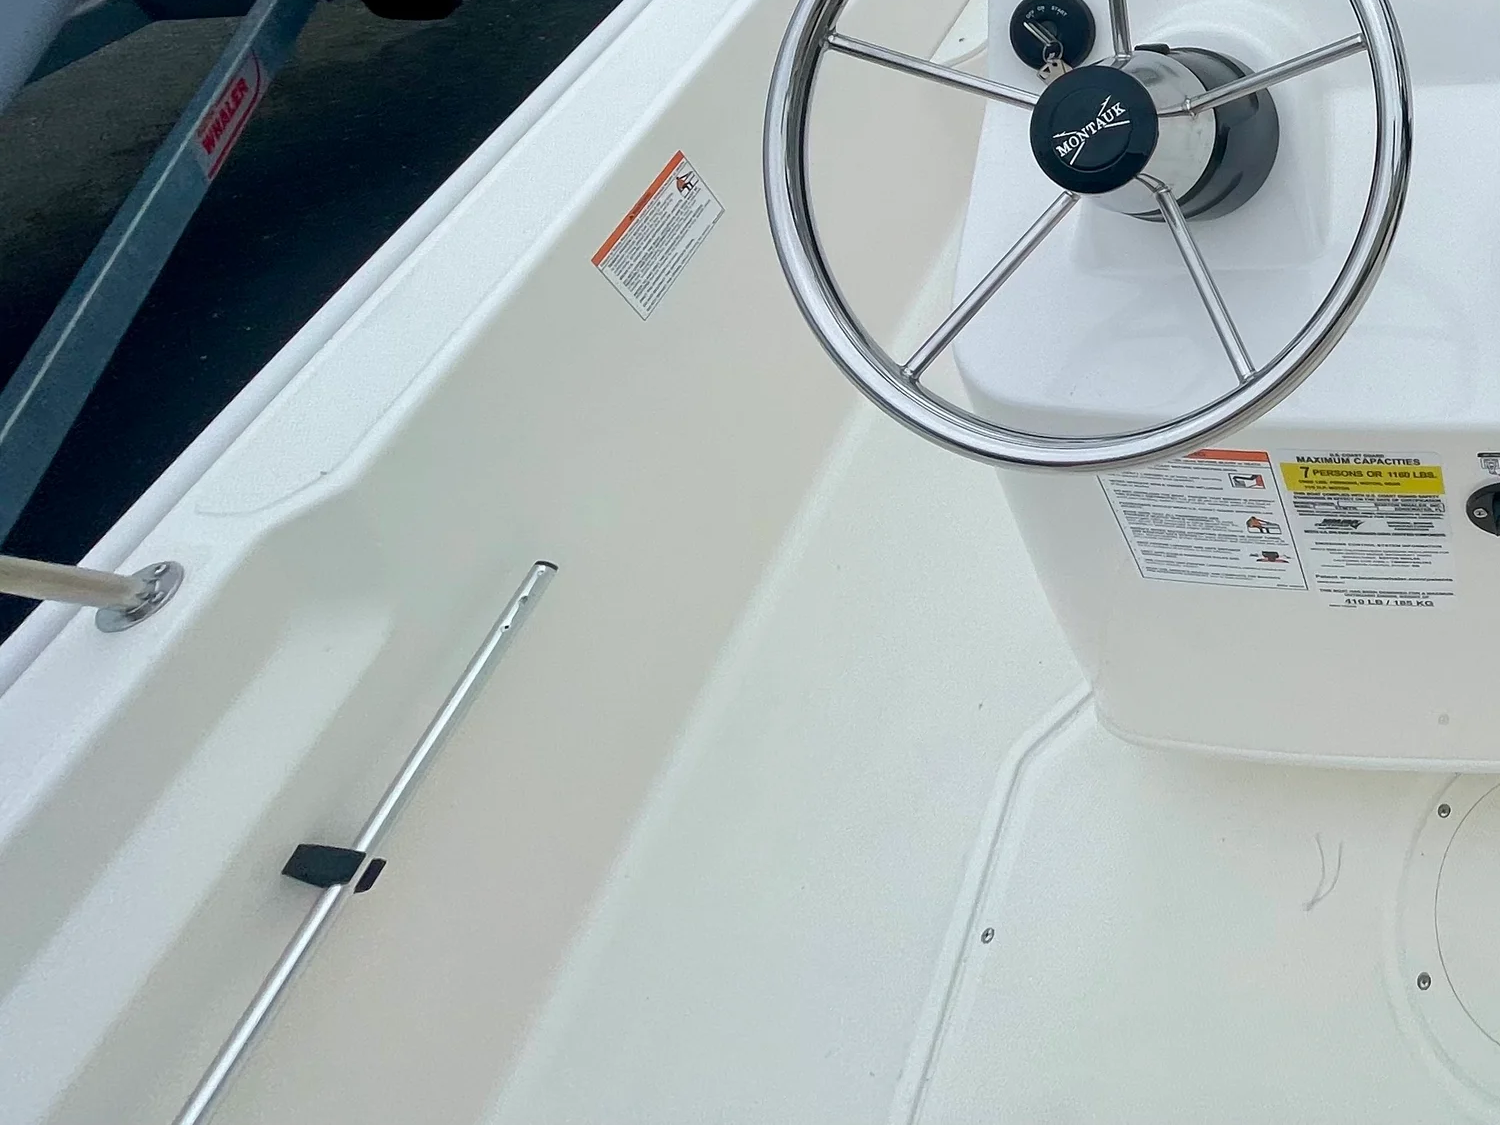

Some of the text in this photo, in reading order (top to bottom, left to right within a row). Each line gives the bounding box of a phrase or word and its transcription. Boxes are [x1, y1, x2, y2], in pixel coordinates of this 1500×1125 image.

[1051, 5, 1068, 17] START
[202, 77, 249, 155] WHALER
[1055, 102, 1126, 158] MONTAUK
[1296, 456, 1421, 466] MAXIMUM CAPACITIES
[1300, 466, 1309, 478] 7
[1313, 469, 1363, 478] PERSONS
